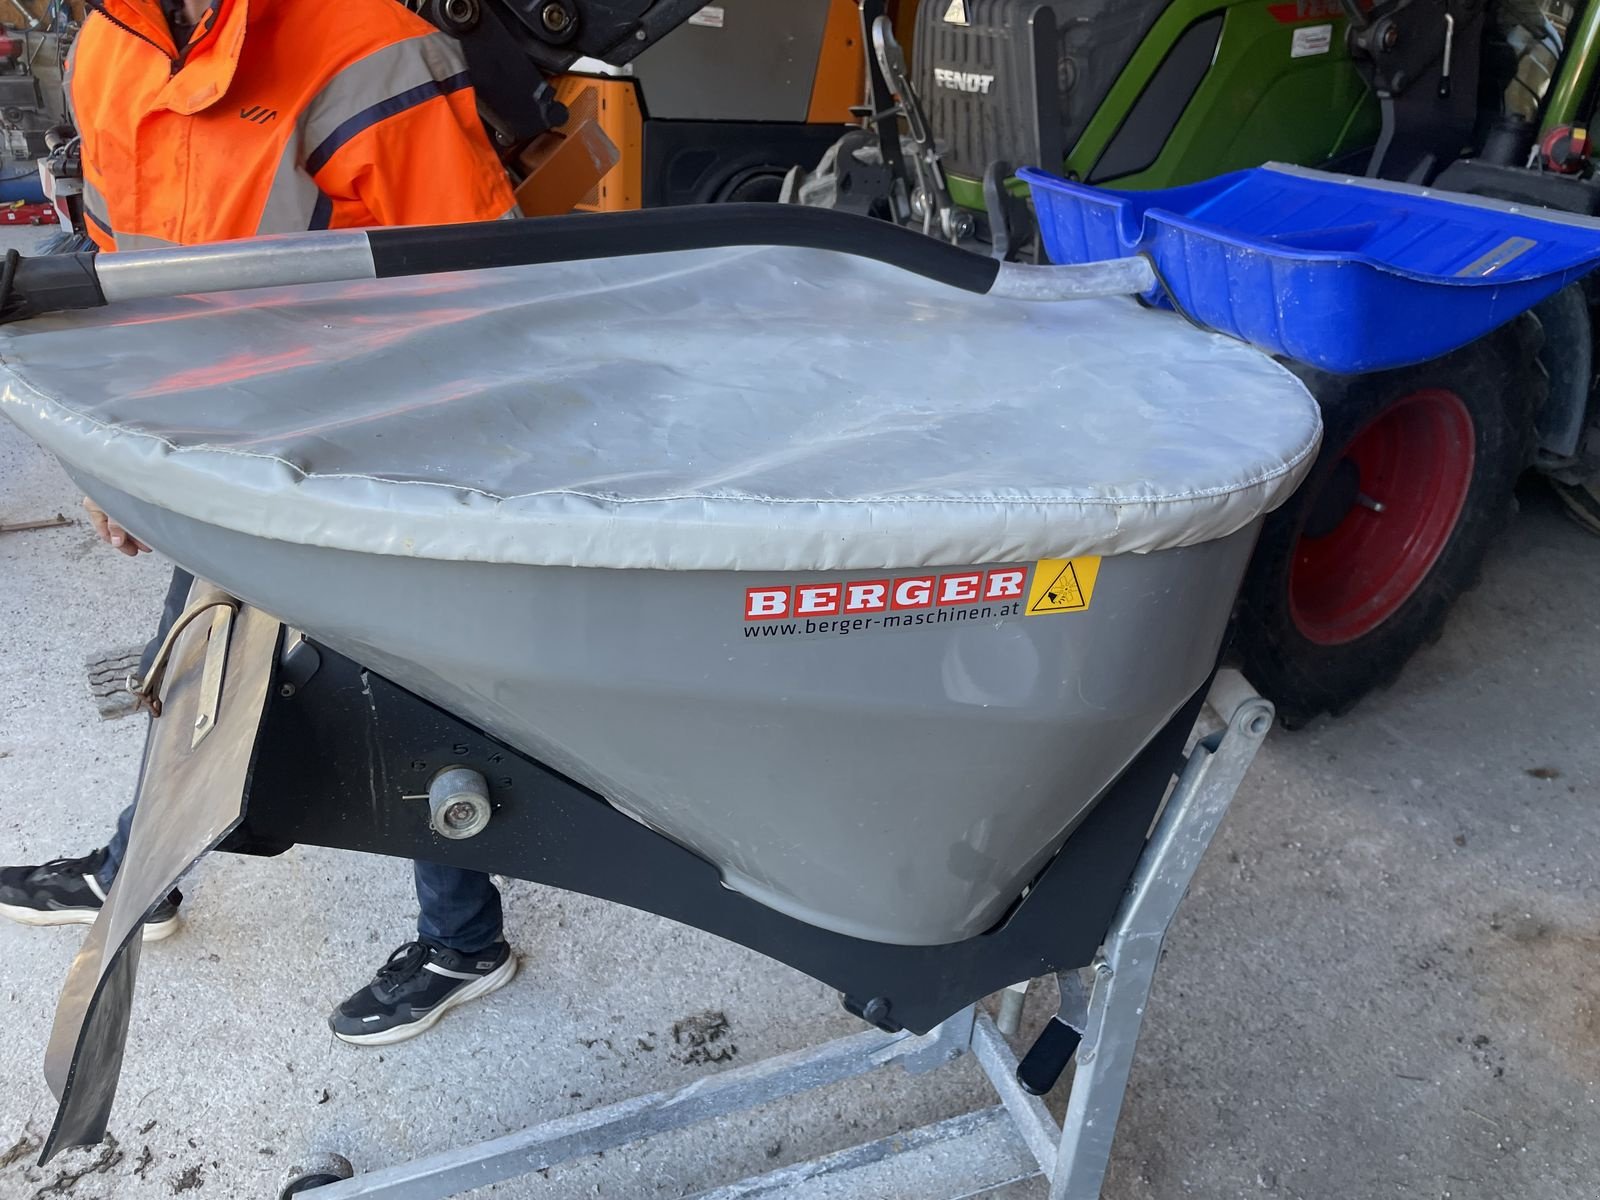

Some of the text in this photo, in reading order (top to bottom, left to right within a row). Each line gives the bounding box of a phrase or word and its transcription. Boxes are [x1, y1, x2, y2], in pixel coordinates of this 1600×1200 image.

[934, 68, 995, 94] FENDT
[747, 571, 1024, 616] BERGER
[744, 601, 1020, 638] www.berger-maschinen.at
[452, 743, 470, 756] 5
